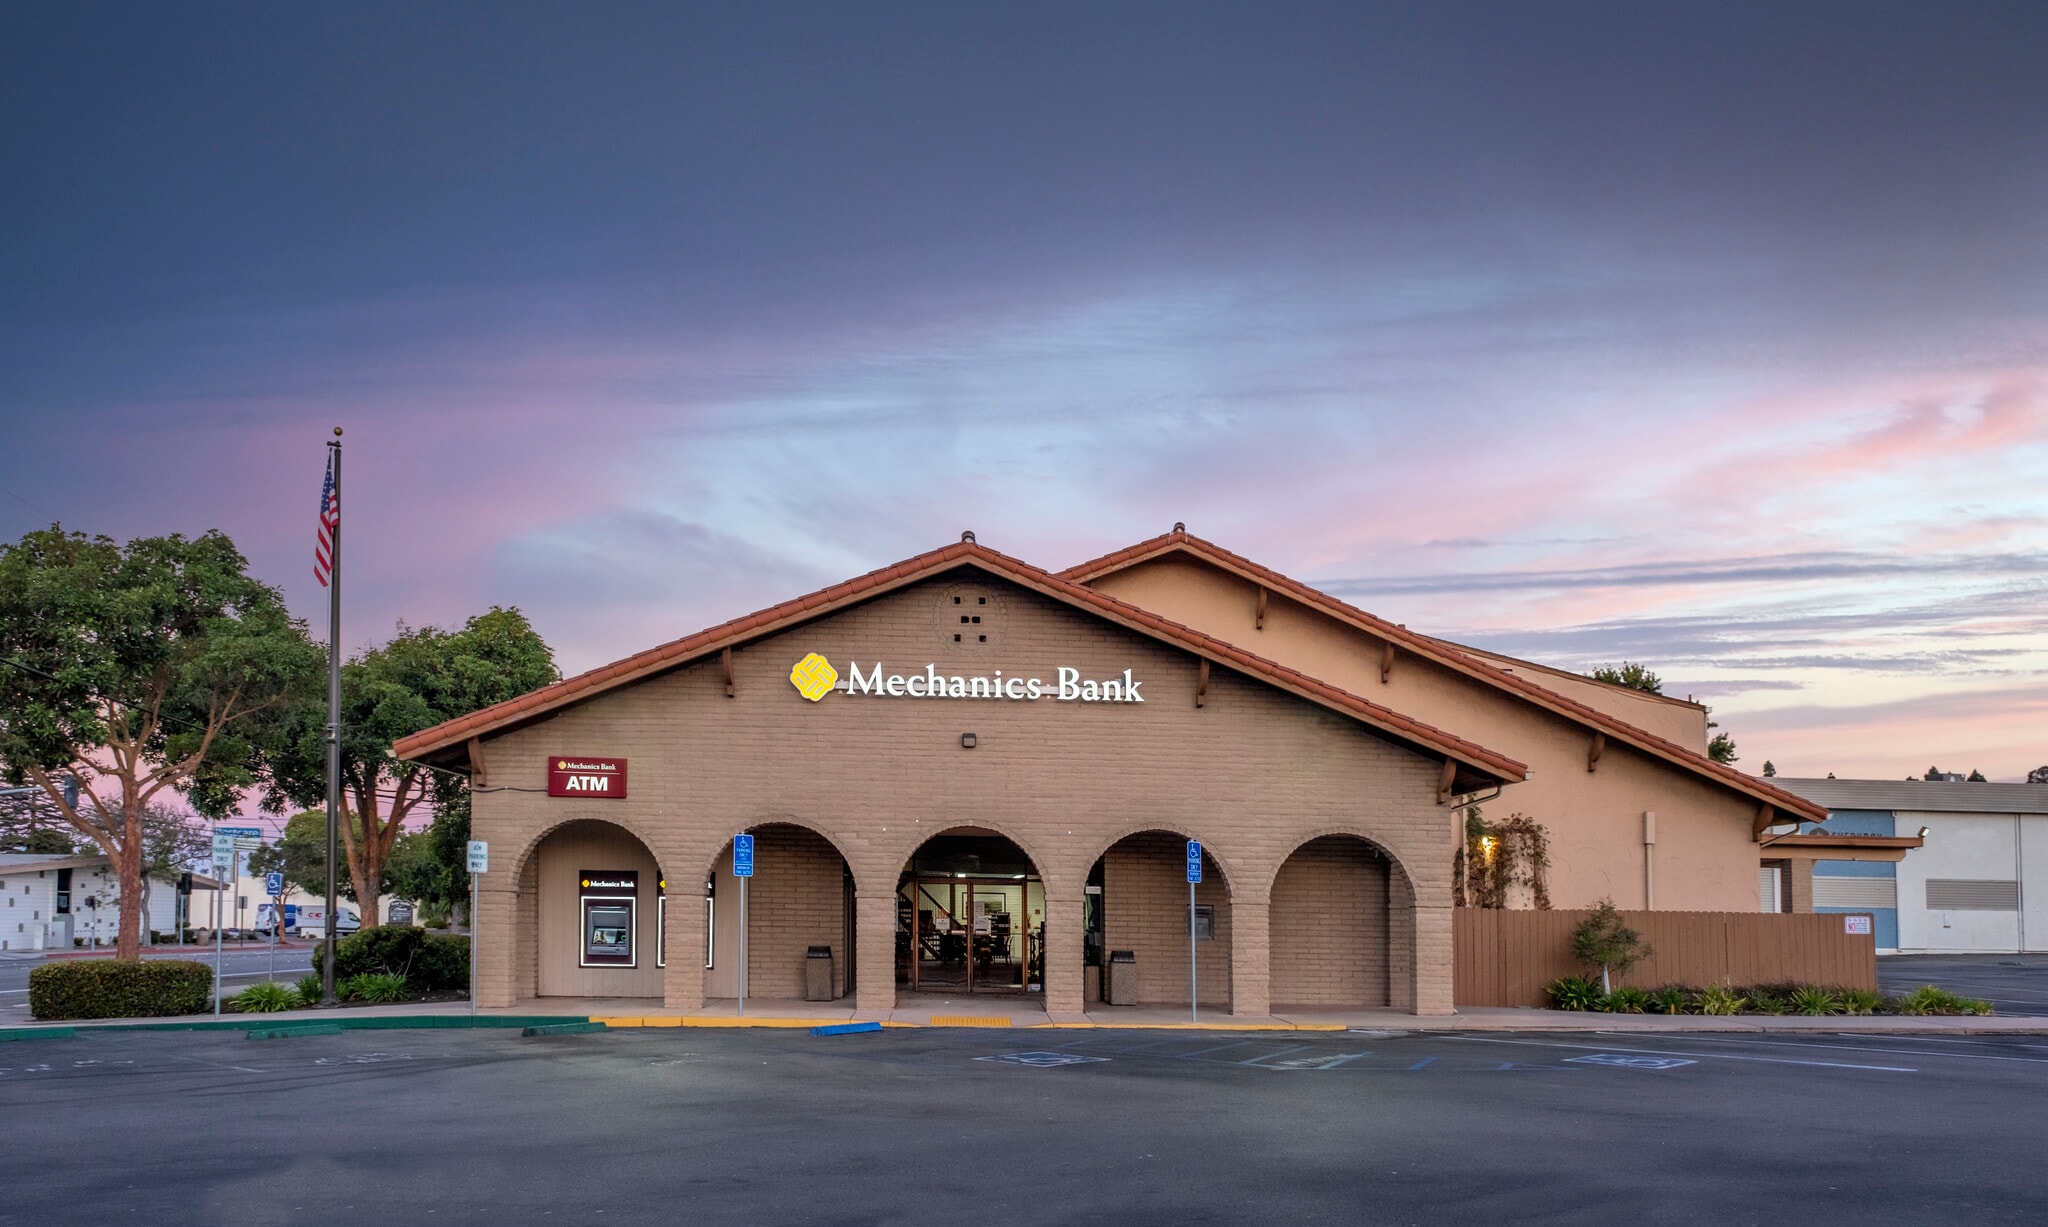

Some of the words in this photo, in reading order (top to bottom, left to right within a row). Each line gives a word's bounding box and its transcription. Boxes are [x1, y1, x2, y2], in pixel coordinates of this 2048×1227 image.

[846, 661, 1042, 699] Mechanics
[1056, 666, 1145, 702] Bank
[567, 762, 600, 770] Mechanics
[600, 763, 616, 771] Bank
[566, 776, 608, 791] ATM
[590, 880, 620, 888] Mechanics
